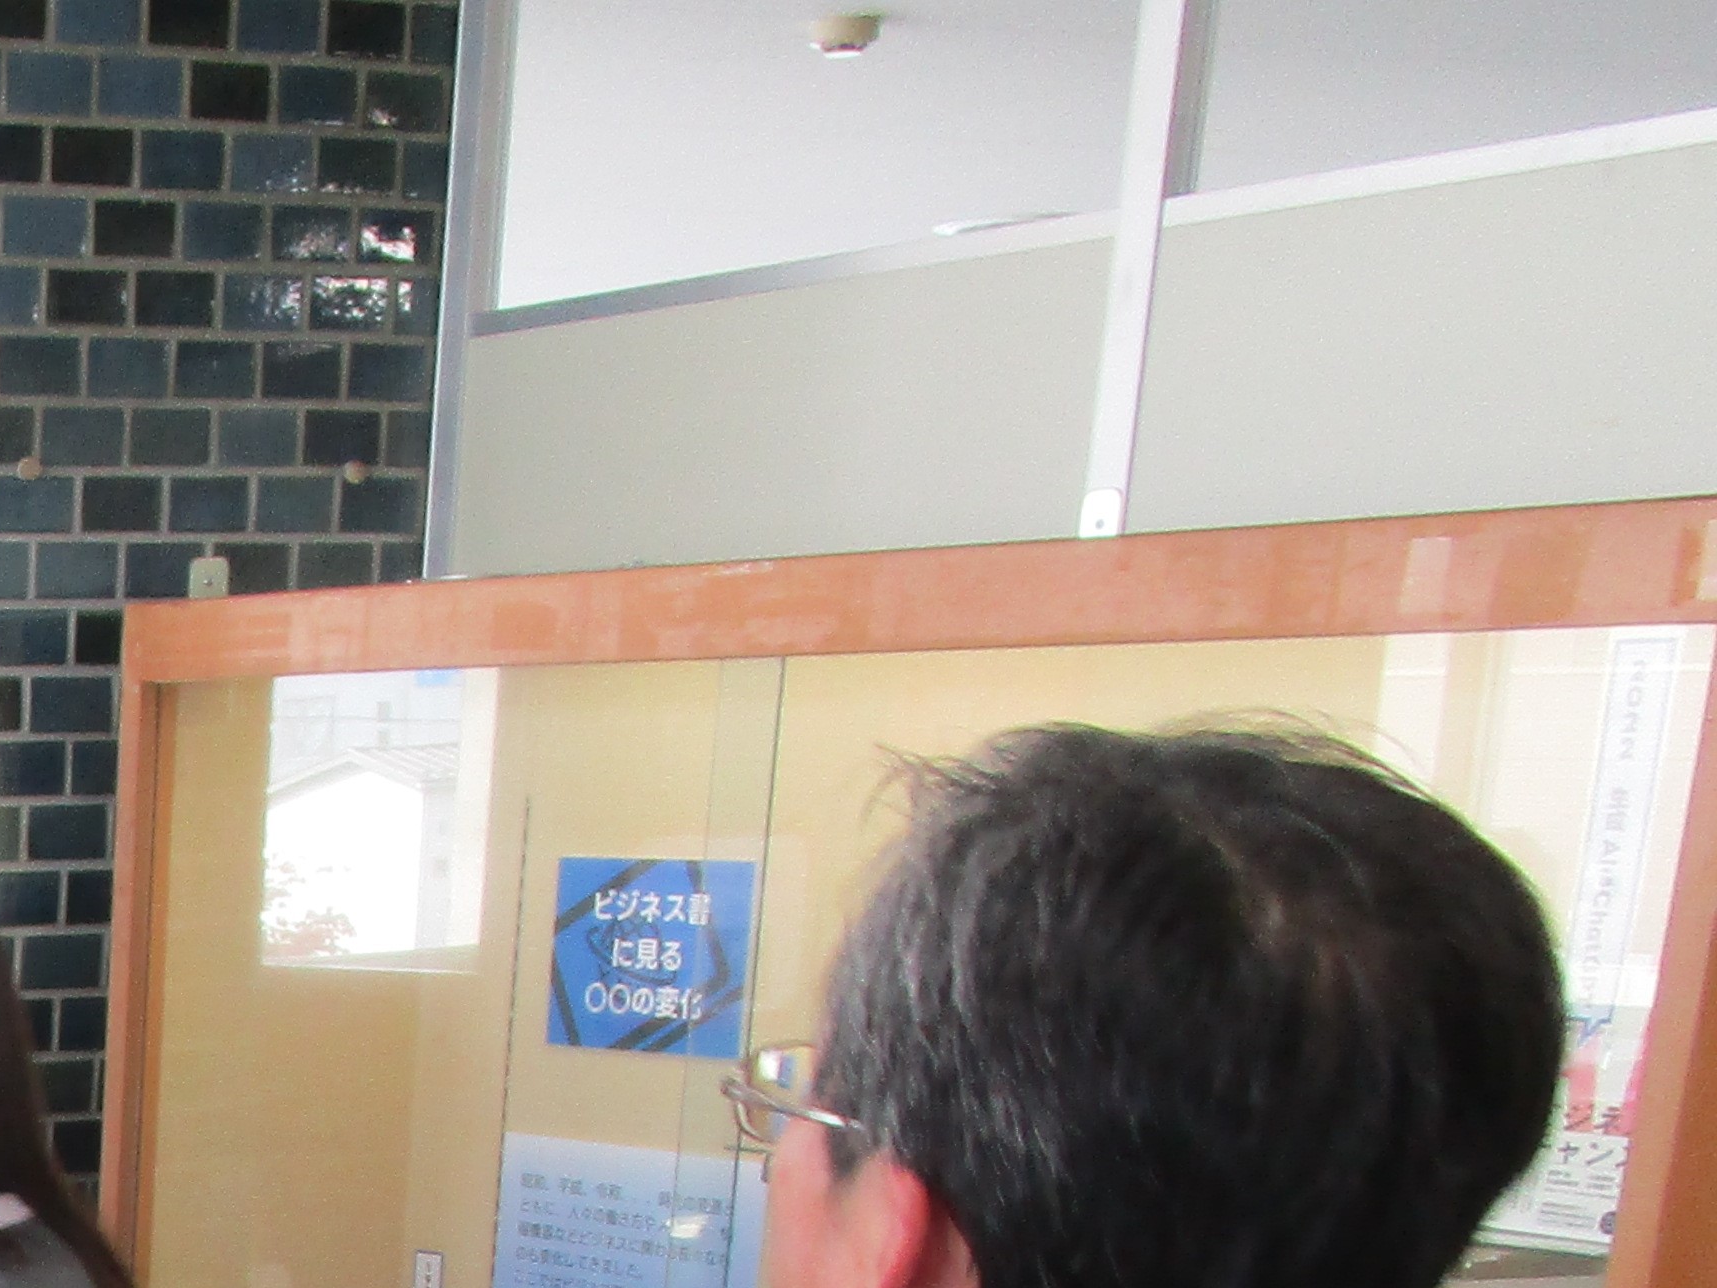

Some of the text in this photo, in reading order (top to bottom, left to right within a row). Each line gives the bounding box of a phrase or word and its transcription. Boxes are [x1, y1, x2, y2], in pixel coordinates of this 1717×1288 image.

[593, 889, 712, 926] ビジネス書
[612, 938, 683, 971] に見る
